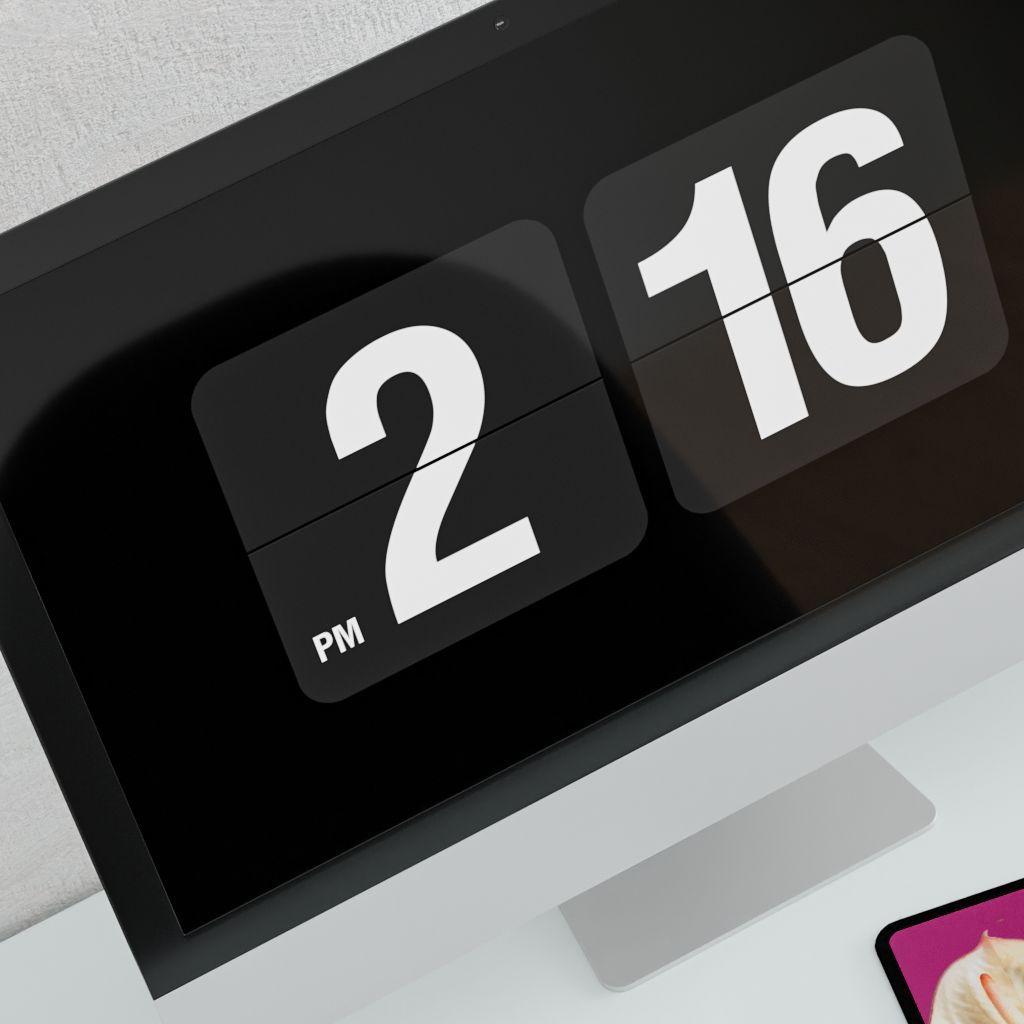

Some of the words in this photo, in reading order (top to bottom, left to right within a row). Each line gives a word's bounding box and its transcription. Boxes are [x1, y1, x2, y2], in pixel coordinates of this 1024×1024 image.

[325, 325, 541, 625] 2
[637, 107, 948, 441] 16
[311, 616, 365, 664] PM
